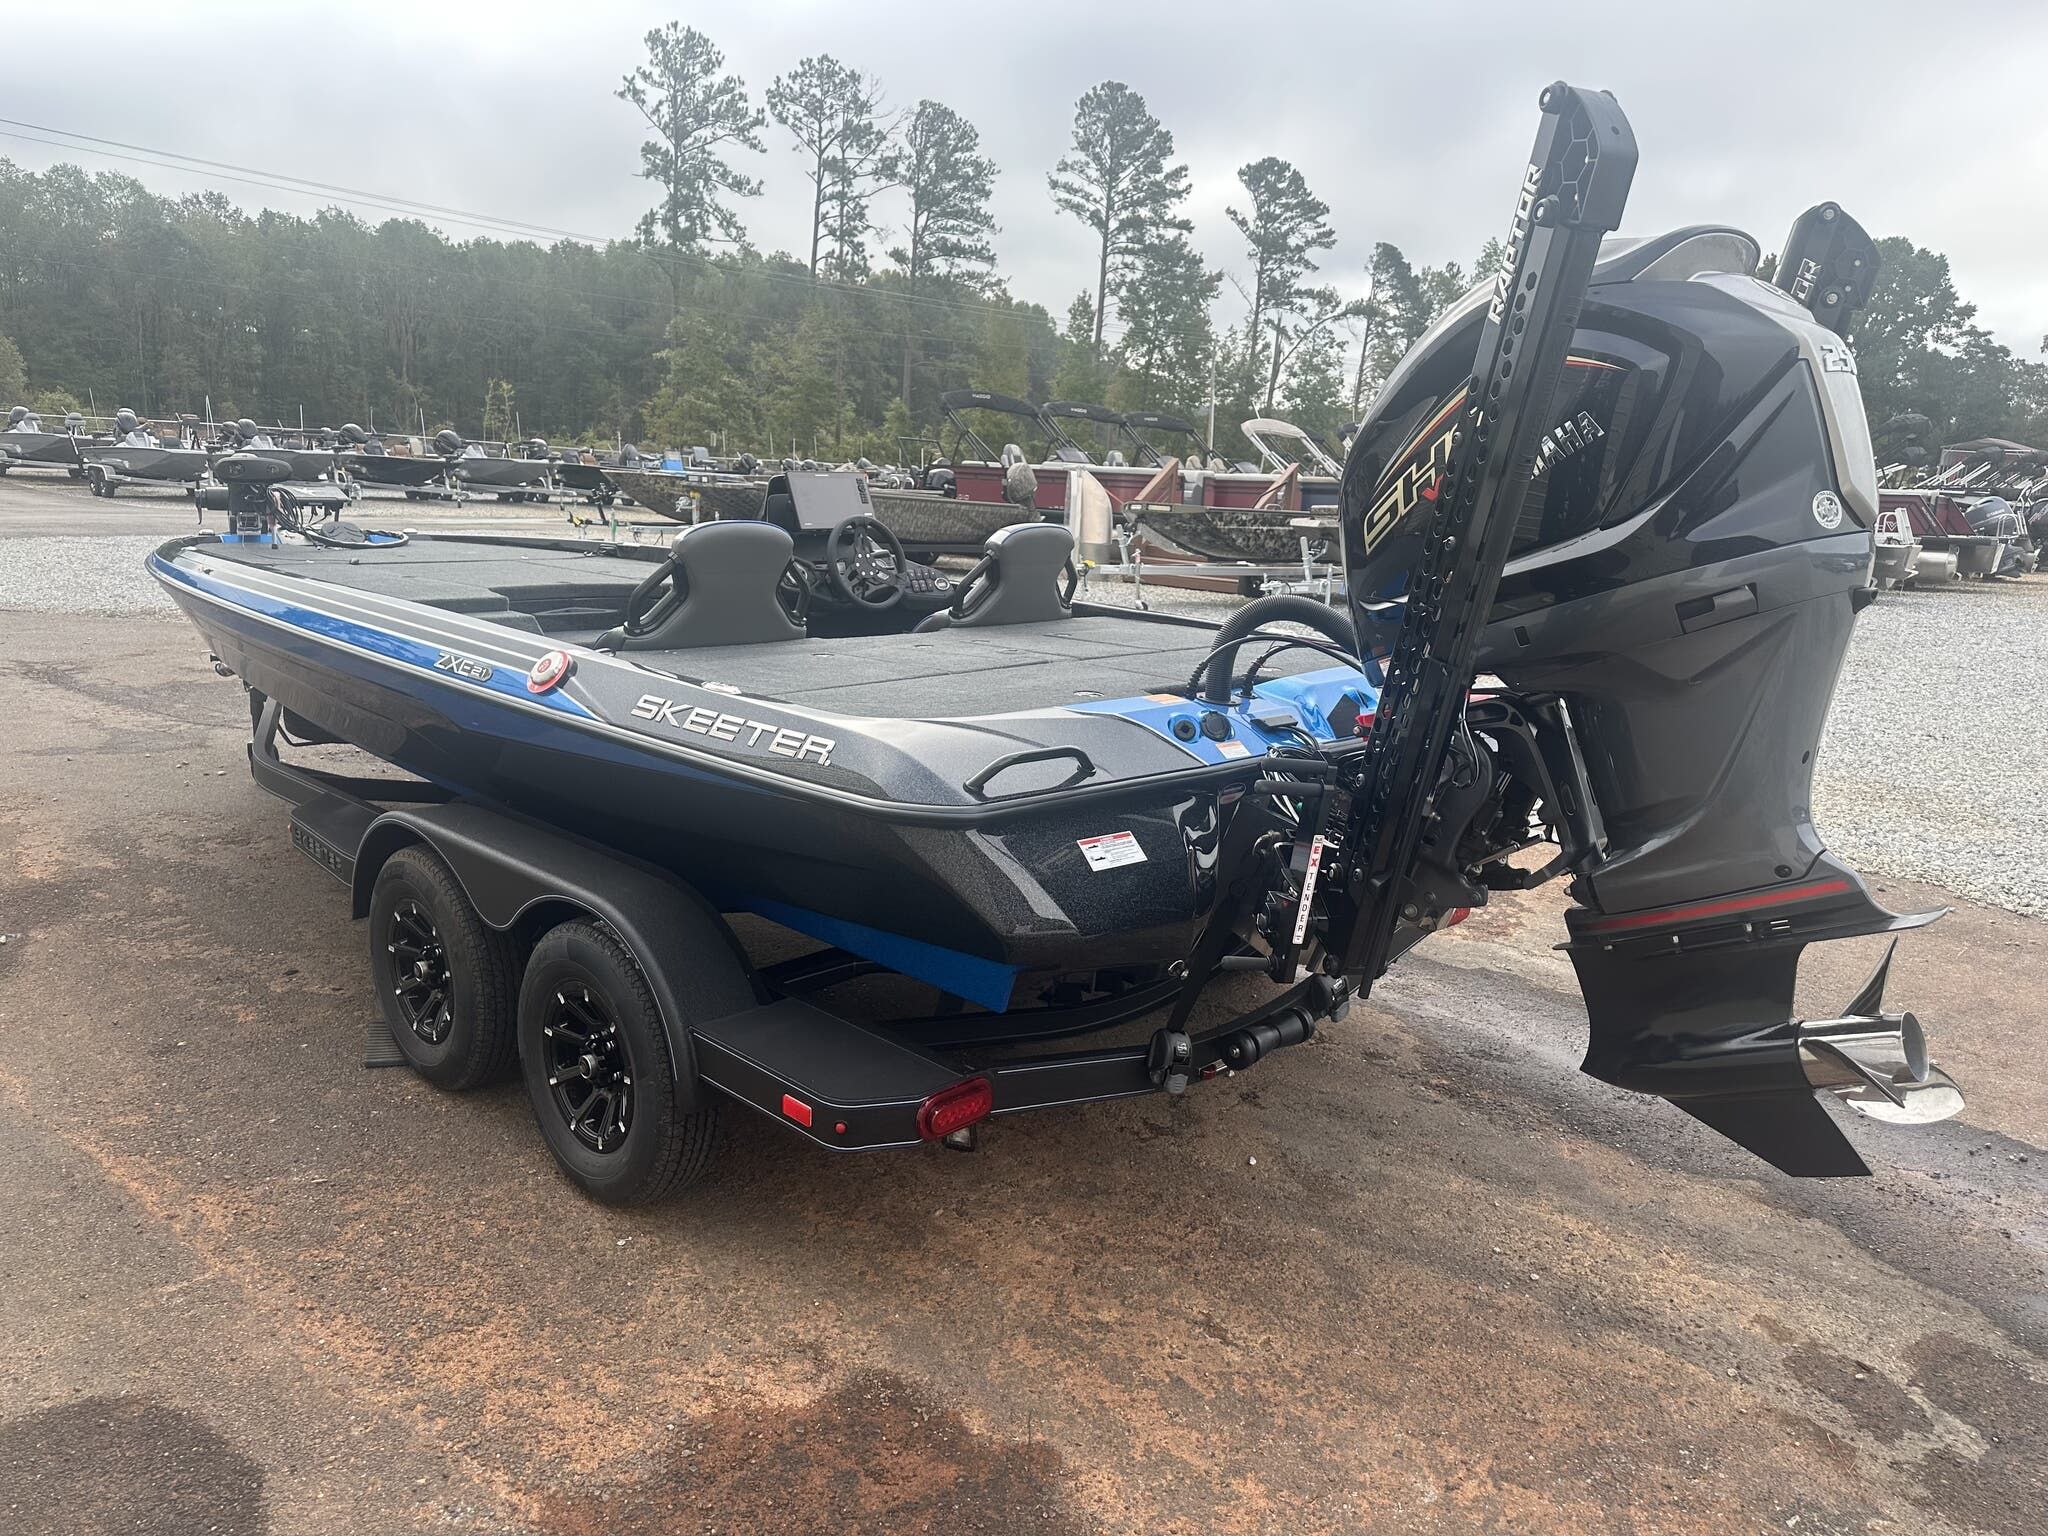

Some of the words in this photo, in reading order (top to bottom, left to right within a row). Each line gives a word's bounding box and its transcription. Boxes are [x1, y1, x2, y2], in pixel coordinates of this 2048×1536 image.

[1488, 163, 1543, 325] RAPTOR
[1363, 422, 1459, 556] SH
[1530, 410, 1605, 481] MAHA
[630, 693, 836, 766] SKEETER
